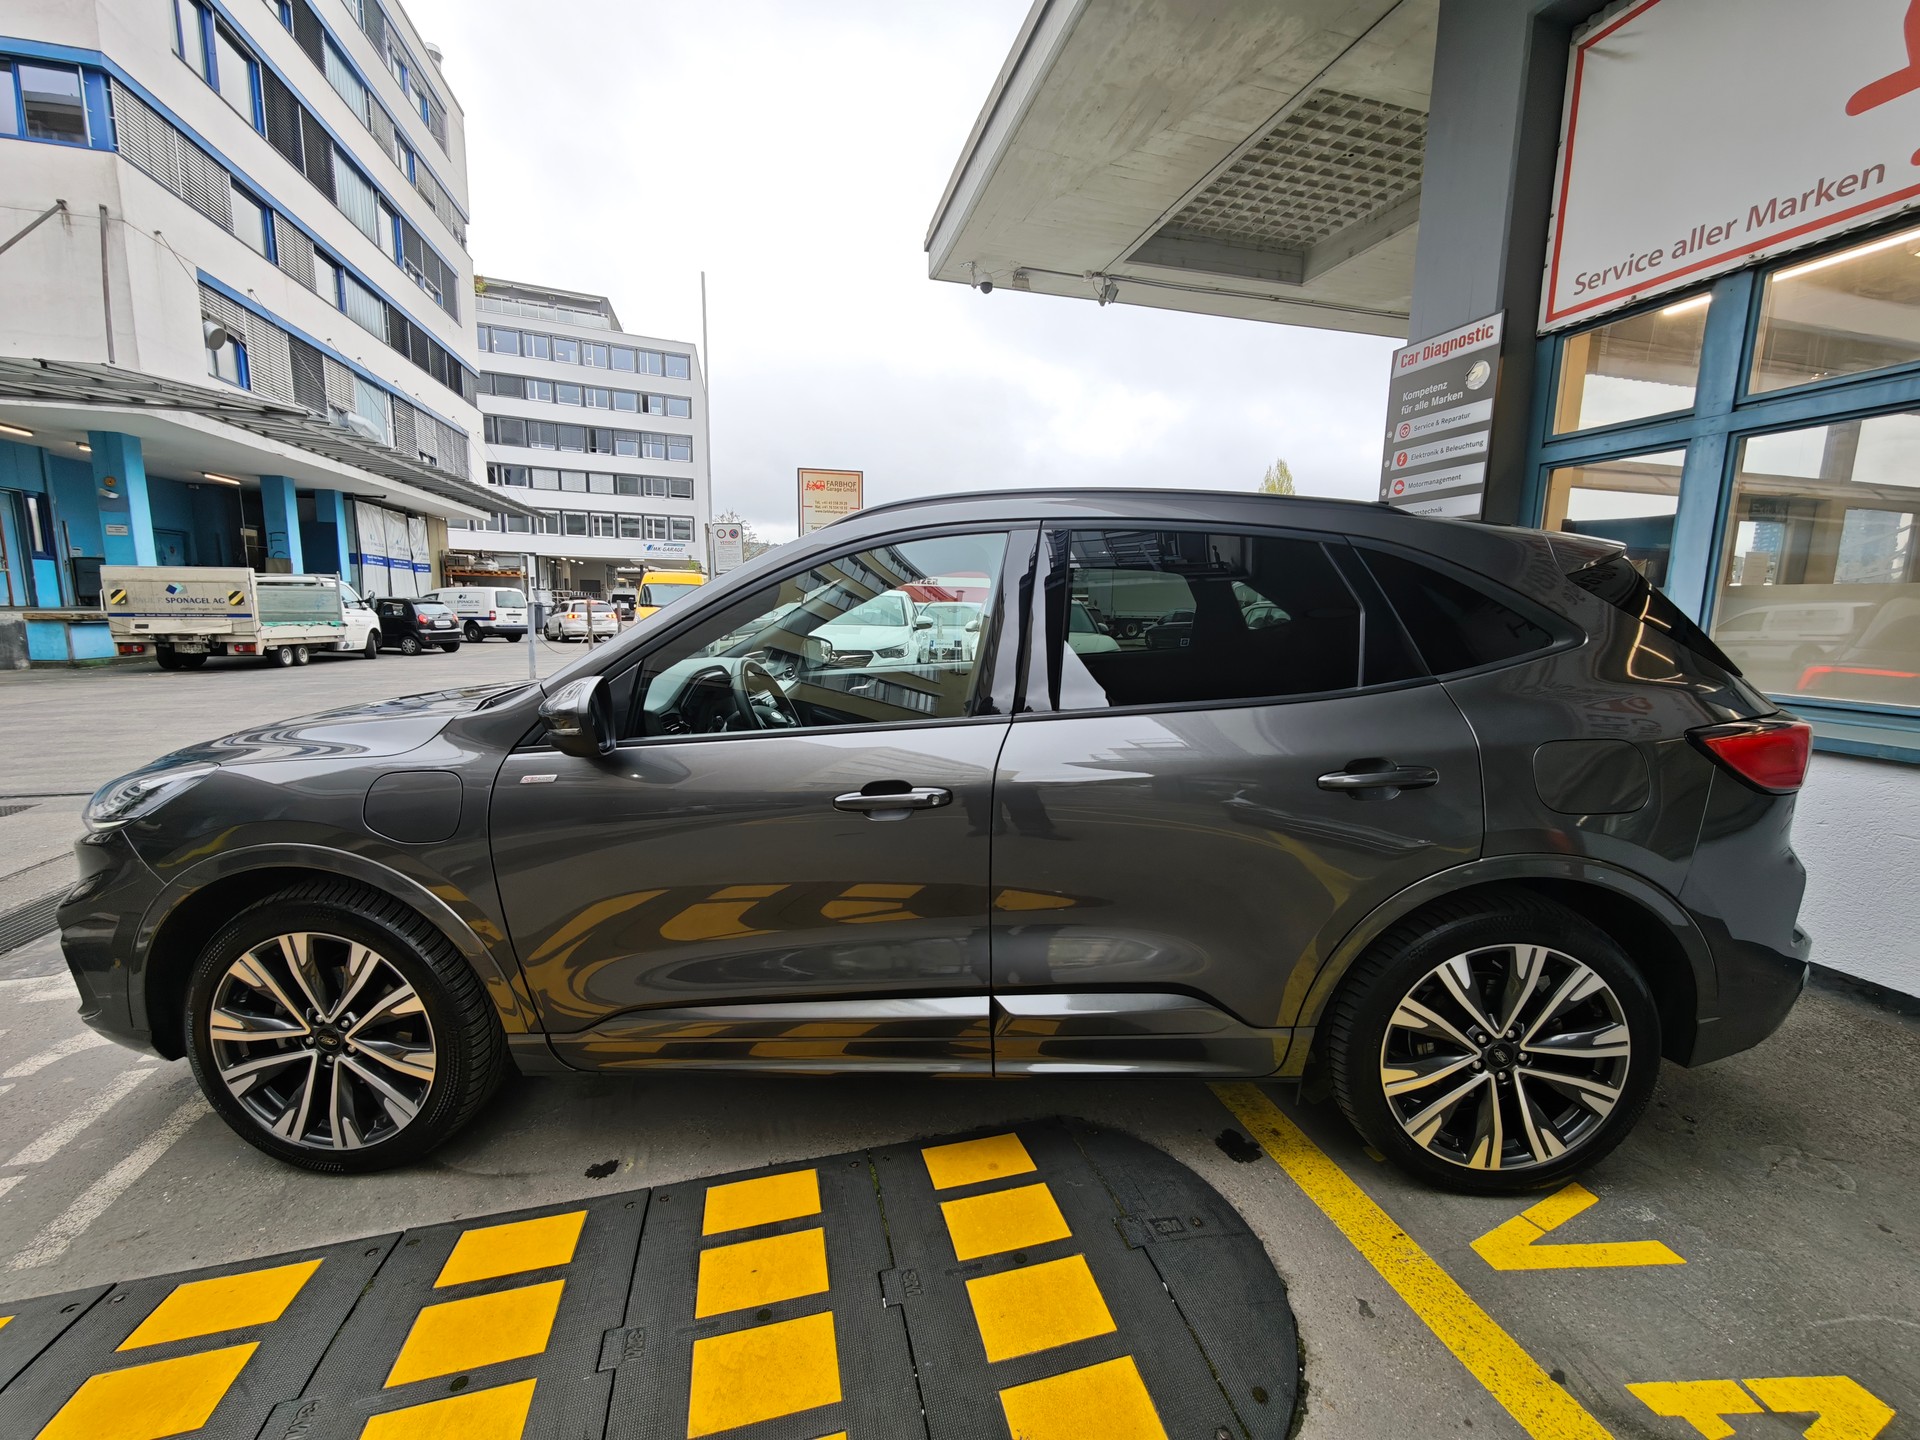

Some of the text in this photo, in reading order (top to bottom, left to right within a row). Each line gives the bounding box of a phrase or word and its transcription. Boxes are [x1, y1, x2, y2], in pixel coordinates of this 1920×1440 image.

[1573, 163, 1886, 296] Service aller Marken
[1401, 324, 1494, 369] Car Diagnostic
[1402, 381, 1448, 402] Kompetenz
[1401, 391, 1463, 415] für alle Marken
[1414, 421, 1435, 431] Service
[1441, 412, 1471, 424] Reparatur
[1411, 449, 1439, 460] Elektronik
[1445, 440, 1484, 453] Beleuchtung
[826, 480, 857, 488] FARBHOF
[1408, 474, 1462, 489] Motormanagement
